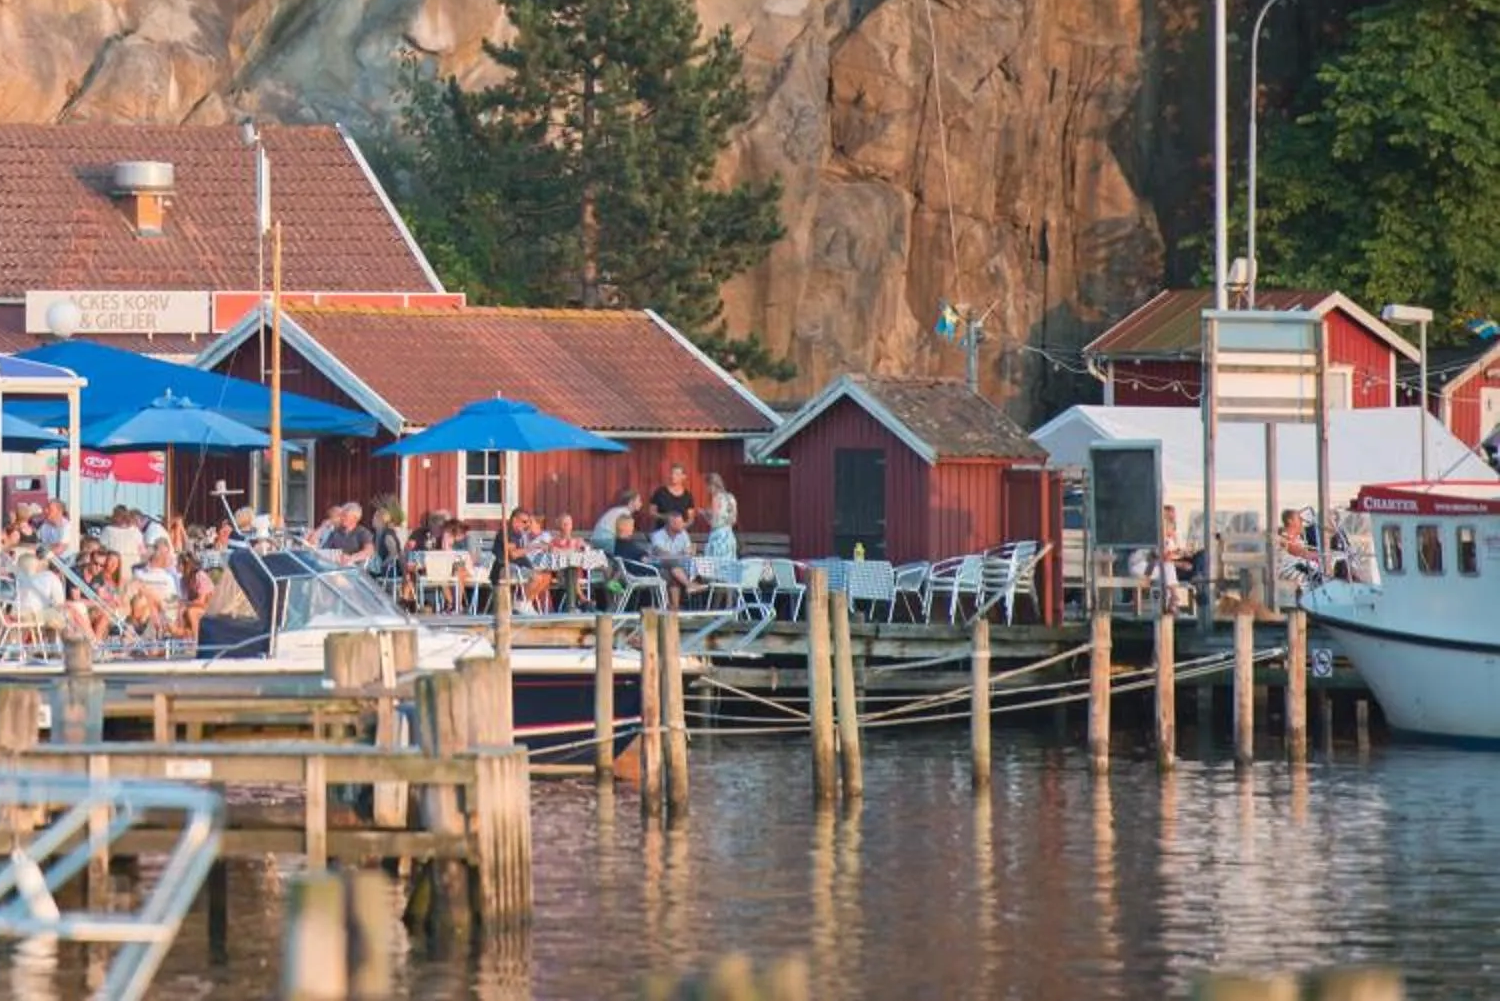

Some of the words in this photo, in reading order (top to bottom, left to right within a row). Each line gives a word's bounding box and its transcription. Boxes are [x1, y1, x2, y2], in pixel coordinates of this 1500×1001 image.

[124, 294, 171, 311] KORV
[79, 312, 91, 329] &
[95, 312, 158, 329] GREJER
